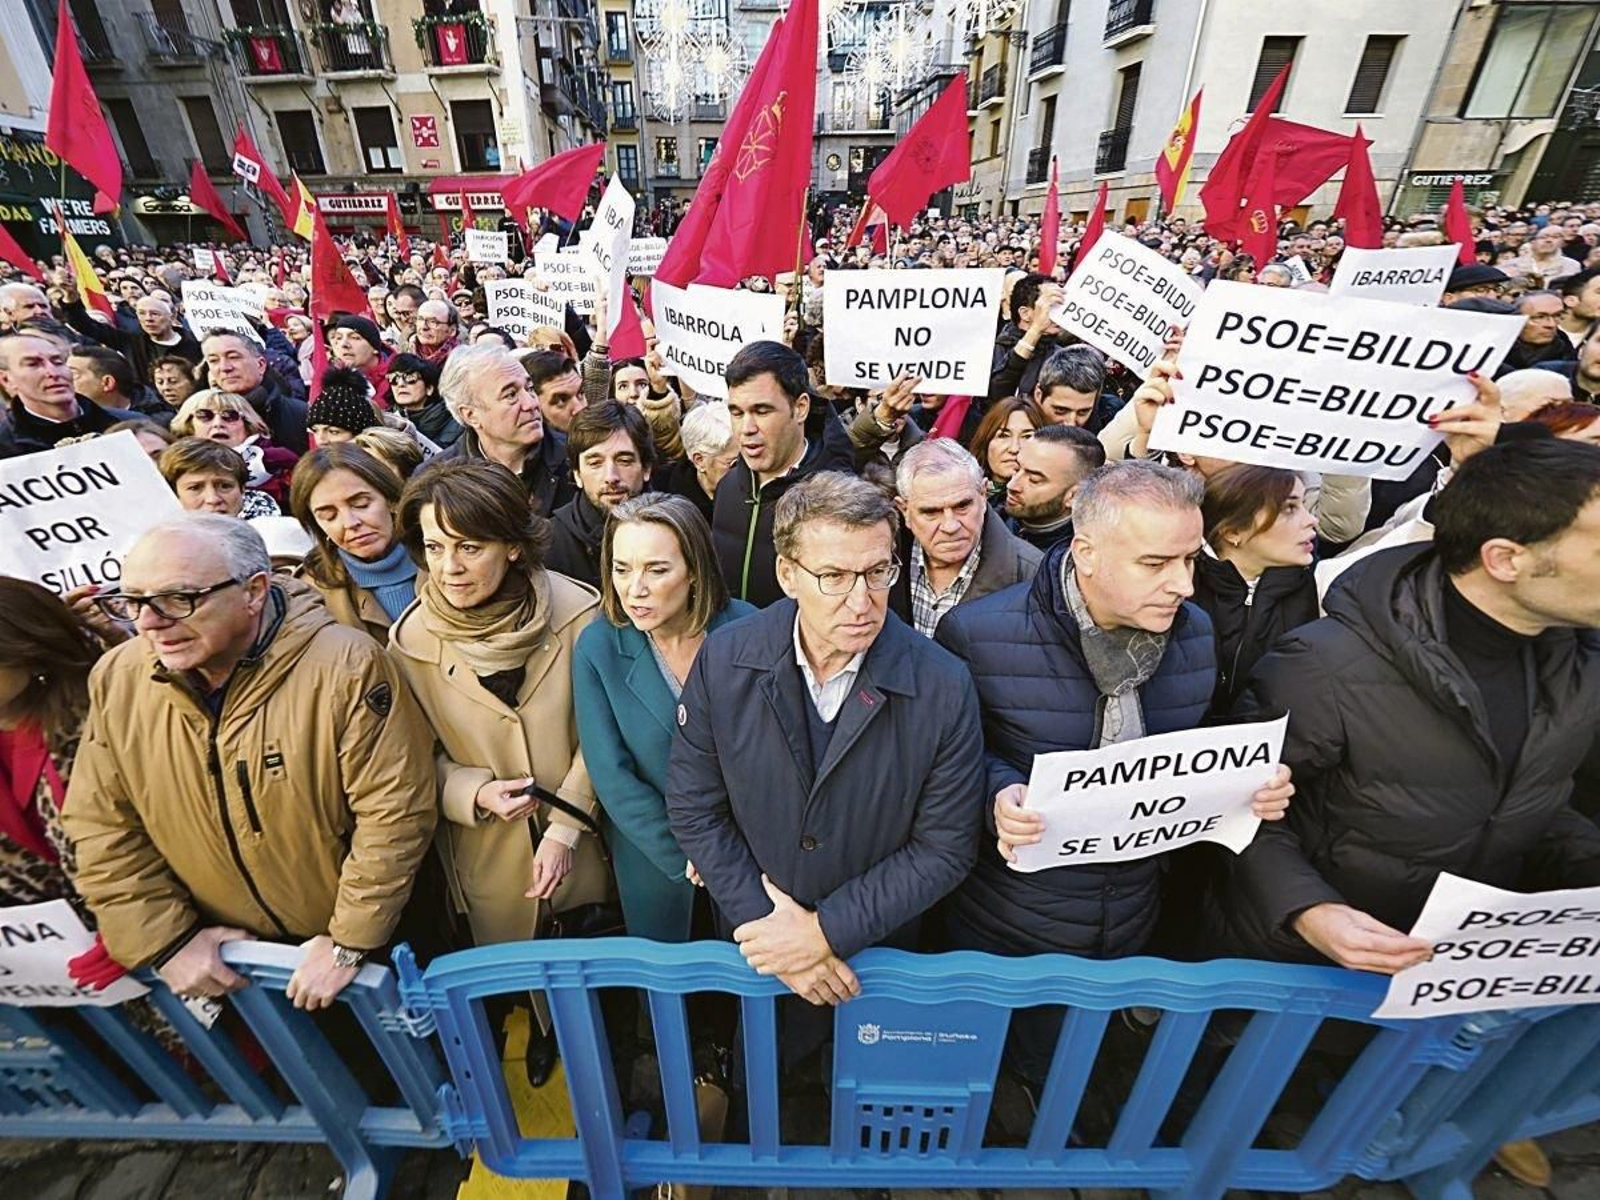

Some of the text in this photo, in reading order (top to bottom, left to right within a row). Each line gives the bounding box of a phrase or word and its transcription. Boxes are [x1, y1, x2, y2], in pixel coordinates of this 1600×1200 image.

[40, 198, 95, 216] WE'RE
[445, 195, 503, 206] GUERREZ
[1099, 248, 1196, 318] PSOE=BILDU
[1351, 268, 1443, 286] IBARROLA
[495, 287, 562, 313] PSOE=BILDU
[846, 287, 987, 309] PAMPLONA
[664, 306, 743, 343] IBARROLA
[895, 327, 932, 346] NO
[1062, 301, 1157, 369] PSOE=BILDU
[1215, 312, 1494, 376] PSOE=BILDU
[855, 360, 966, 380] SE VENDE
[1195, 364, 1455, 425] PSOE=BILDU
[1178, 410, 1420, 467] PSOE=BILDU
[25, 516, 109, 551] POR
[1063, 742, 1271, 792] PAMPLONA
[1130, 796, 1187, 820] NO
[1059, 815, 1222, 856] SE VENDE
[1458, 908, 1600, 930] PSOE=
[1411, 975, 1600, 1006] PSOE=BIL
